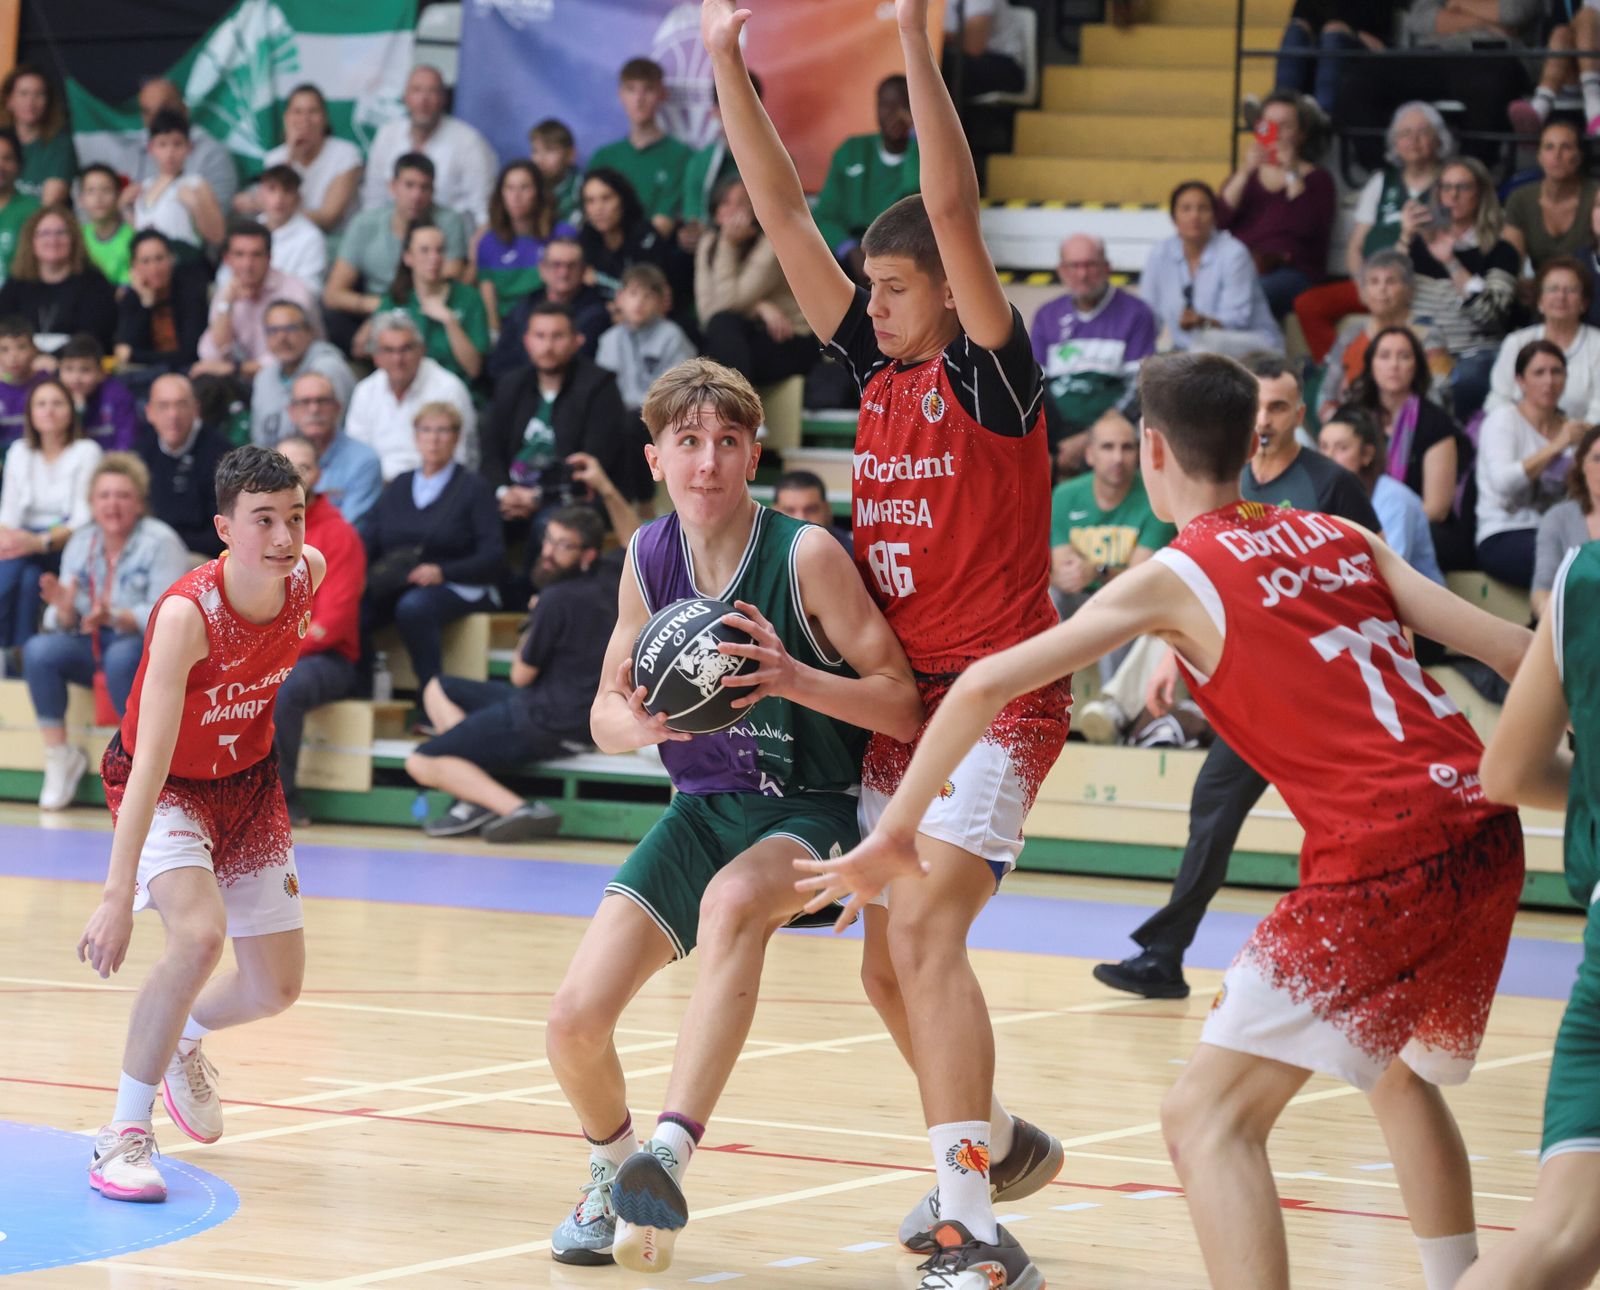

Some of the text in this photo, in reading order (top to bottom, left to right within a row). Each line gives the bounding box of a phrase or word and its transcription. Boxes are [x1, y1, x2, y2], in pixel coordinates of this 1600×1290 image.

[864, 451, 955, 482] Ocident
[868, 540, 917, 598] 86
[639, 601, 712, 674] SPALDING
